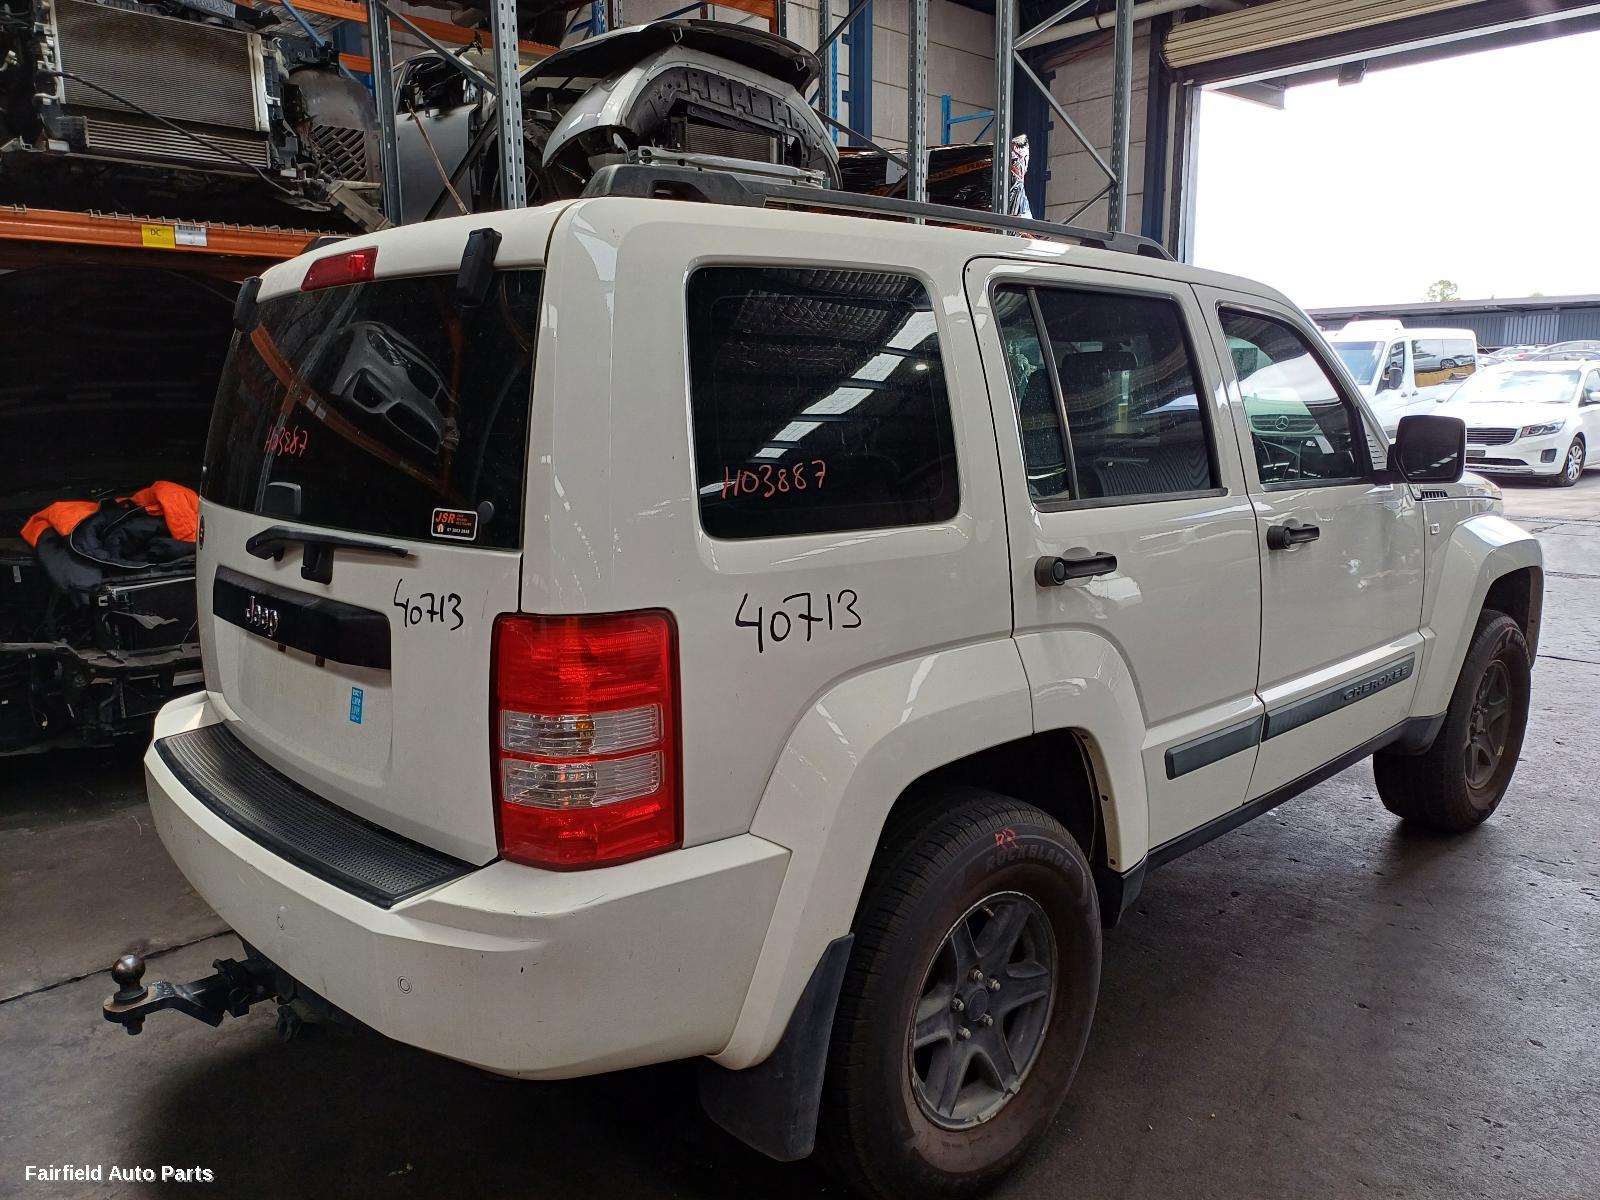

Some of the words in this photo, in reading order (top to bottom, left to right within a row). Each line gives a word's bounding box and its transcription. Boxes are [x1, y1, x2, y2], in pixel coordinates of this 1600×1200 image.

[435, 512, 456, 524] JSR
[245, 595, 279, 637] Jeep
[393, 578, 464, 631] 40713
[735, 589, 862, 653] 40713
[1343, 665, 1409, 701] CHEROKEE
